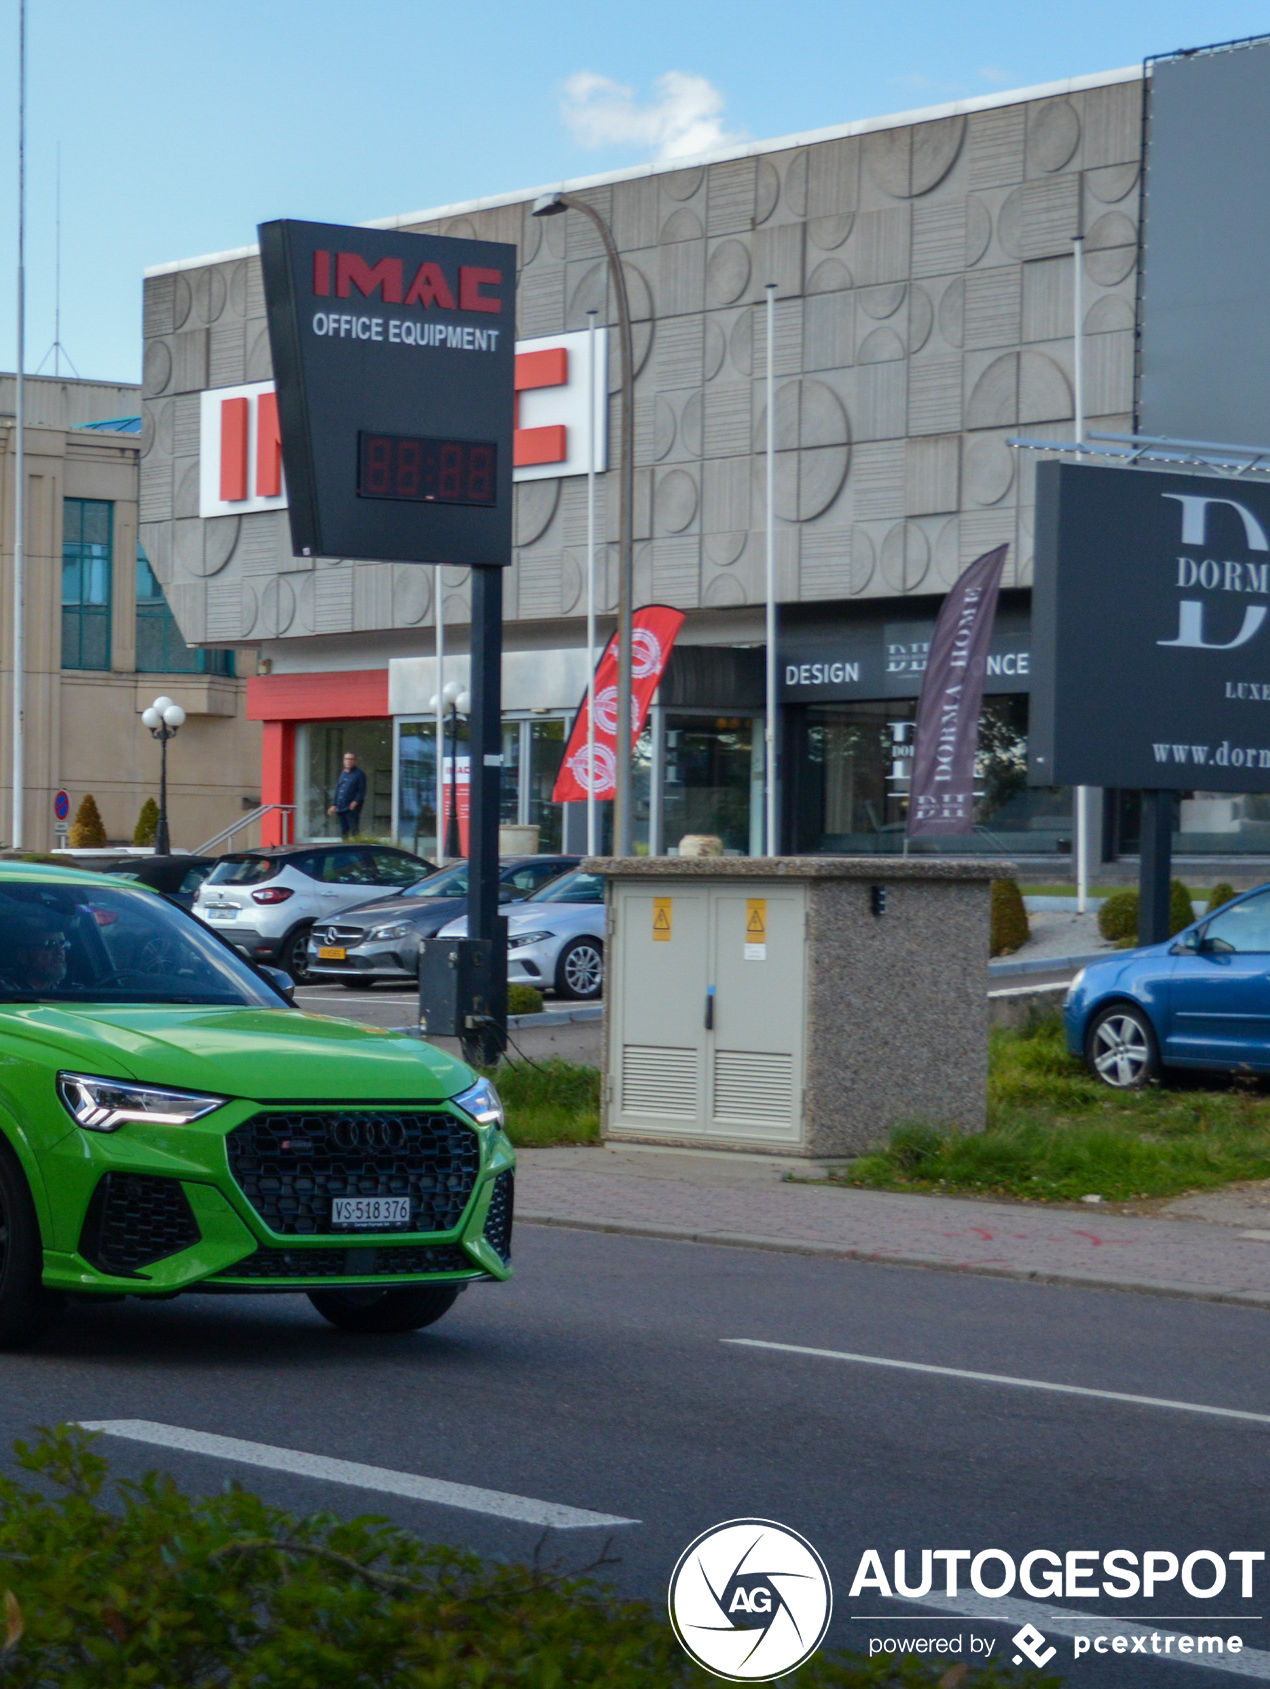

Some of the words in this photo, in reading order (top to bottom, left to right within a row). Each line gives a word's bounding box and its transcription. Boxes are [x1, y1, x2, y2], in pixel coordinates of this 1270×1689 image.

[313, 249, 502, 315] IMAC
[312, 313, 384, 342] OFFICE
[388, 320, 500, 352] EQUIPMENT
[785, 662, 860, 686] DESIGN
